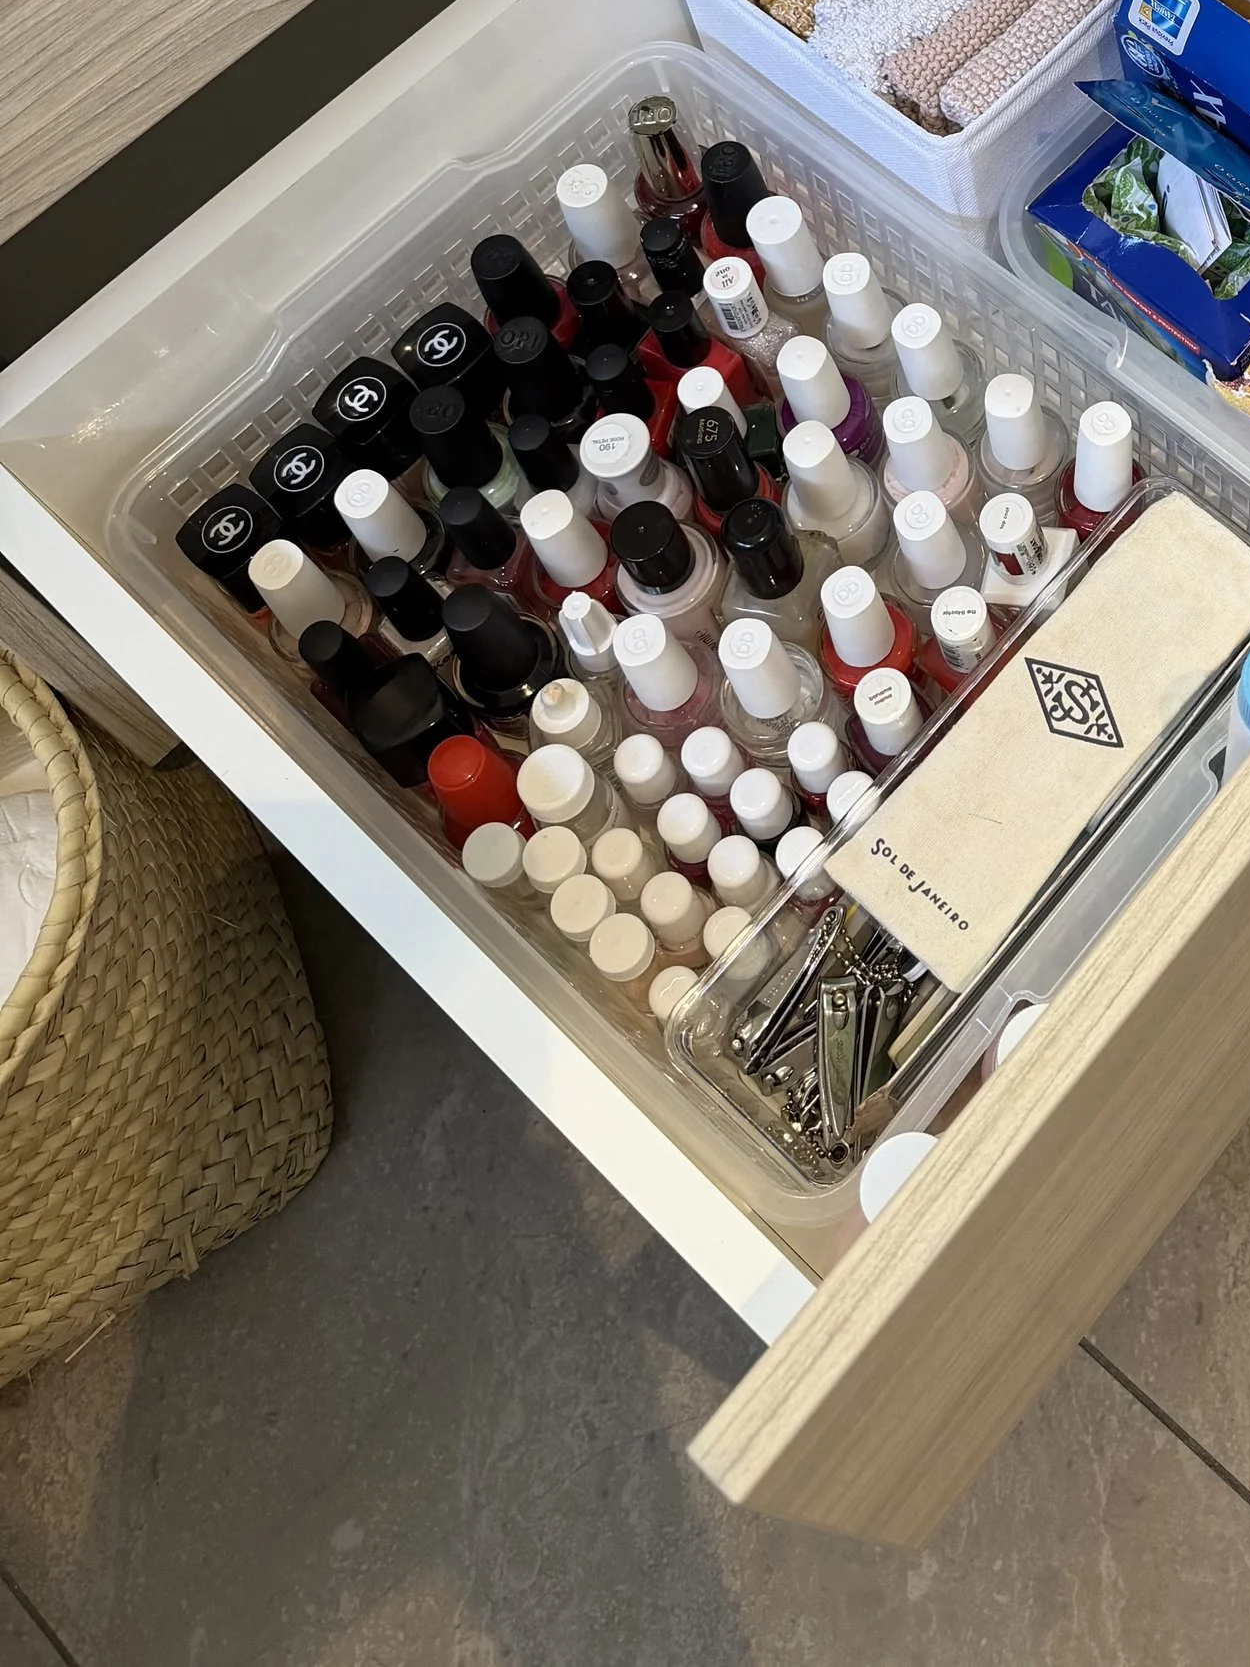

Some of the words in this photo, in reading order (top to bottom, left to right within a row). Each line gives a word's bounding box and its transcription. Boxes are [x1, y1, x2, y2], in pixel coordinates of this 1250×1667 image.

[1138, 17, 1152, 31] Pack
[1152, 26, 1174, 47] Previous
[713, 265, 732, 277] one
[721, 276, 735, 290] All
[704, 418, 720, 442] 675
[598, 441, 617, 452] 190
[868, 685, 893, 702] bahama
[873, 693, 893, 706] mama
[871, 838, 896, 865] SOL
[899, 863, 916, 881] DE
[907, 880, 970, 931] JANEIRO
